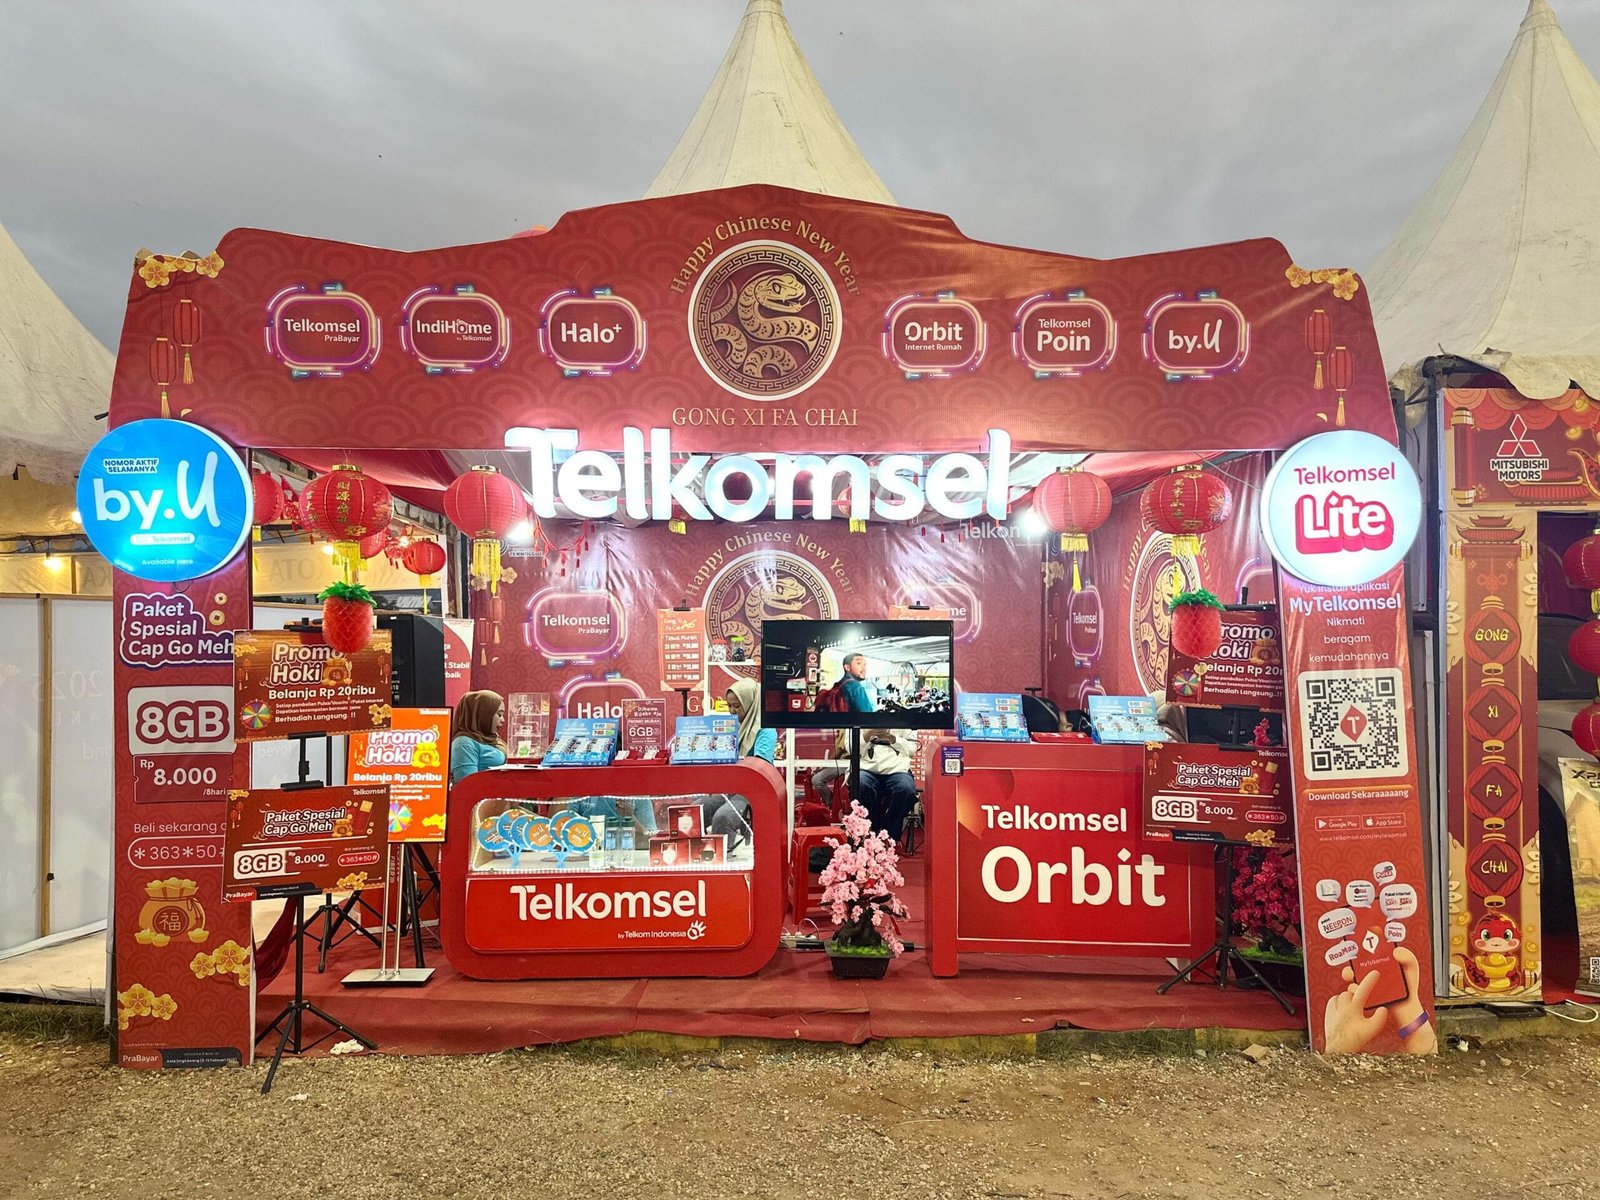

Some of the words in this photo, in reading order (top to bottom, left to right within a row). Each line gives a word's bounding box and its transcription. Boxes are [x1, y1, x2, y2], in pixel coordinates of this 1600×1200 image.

[670, 236, 715, 295] Happy
[714, 216, 792, 241] Chinese
[795, 219, 836, 254] New
[833, 250, 860, 296] Year
[284, 318, 361, 333] Telkomsel
[416, 318, 492, 335] IndiHome
[1038, 318, 1091, 329] Telkomsel
[904, 321, 963, 341] Orbit
[1168, 318, 1223, 354] by.U
[324, 334, 360, 343] PraBayar
[1037, 330, 1091, 352] Poin
[905, 343, 935, 351] Internet
[936, 343, 962, 351] Rumah
[672, 407, 735, 426] GONG
[742, 408, 765, 426] XI
[772, 408, 799, 426] FA
[805, 408, 859, 427] CHAI
[1491, 460, 1548, 470] MITSUBISHI
[504, 426, 1011, 522] Telkomsel
[1294, 461, 1396, 485] Telkomsel
[1499, 470, 1541, 480] MOTORS
[93, 451, 221, 530] by.U
[1299, 493, 1389, 546] Lite
[686, 547, 725, 598] Happy
[725, 531, 792, 552] Chinese
[796, 533, 830, 560] New
[829, 557, 854, 594] Year
[1349, 580, 1390, 593] aplikasi
[131, 601, 185, 617] Paket
[1289, 593, 1401, 616] MyTelkomsel
[542, 613, 611, 627] Telkomsel
[1072, 612, 1098, 624] Telkomsel
[1326, 616, 1365, 627] Nikmati
[129, 620, 197, 640] Spesial
[578, 627, 610, 635] PraBayar
[1220, 625, 1275, 640] romo
[1475, 628, 1509, 641] GONG
[1323, 634, 1371, 646] beragam
[128, 640, 163, 659] Cap
[168, 640, 194, 655] Go
[197, 639, 234, 654] Meh
[1308, 652, 1389, 663] kemudahannya
[448, 661, 471, 669] Stabil
[1247, 665, 1263, 676] Rp
[272, 663, 321, 683] Hoki
[268, 687, 317, 701] Belanja
[319, 687, 336, 700] Rp
[338, 685, 376, 697] 20ribu
[1204, 687, 1239, 695] Berhadiah
[275, 714, 313, 723] Berhadiah
[1487, 705, 1499, 719] XI
[139, 703, 227, 742] 8GB
[370, 731, 434, 745] Promo
[629, 727, 653, 736] 6GB
[367, 746, 412, 764] Hoki
[140, 759, 154, 769] Rp
[1178, 764, 1209, 774] Paket
[1211, 766, 1251, 777] Spesial
[153, 767, 217, 786] 8.000
[353, 773, 392, 784] Belanja
[394, 773, 408, 783] Rp
[410, 772, 442, 782] 20ribu
[1177, 775, 1199, 787] Cap
[1200, 777, 1215, 785] Go
[1217, 777, 1239, 787] Meh
[202, 788, 226, 796] /8hari
[352, 787, 387, 796] Telkomsel
[1308, 791, 1350, 801] Download
[1486, 784, 1503, 797] FA
[266, 811, 300, 823] Paket
[301, 809, 345, 821] Spesial
[1155, 800, 1195, 818] 8GB
[1205, 806, 1233, 815] 8.000
[981, 804, 1127, 832] Telkomsel
[133, 823, 155, 833] Beli
[159, 821, 217, 834] sekarang
[264, 824, 288, 836] Cap
[290, 823, 306, 833] Go
[308, 821, 333, 831] Meh
[237, 853, 283, 875] 8GB
[294, 853, 326, 865] 8.000
[1480, 860, 1508, 874] CHAI
[981, 845, 1166, 907] Orbit
[225, 891, 254, 899] PraBayar
[510, 879, 706, 921] Telkomsel
[158, 912, 182, 931] 福
[624, 930, 651, 938] Telkom
[651, 929, 687, 938] Indonesia
[1387, 930, 1402, 938] Poin
[1328, 944, 1357, 961] RoaMax
[122, 1054, 158, 1063] PraBayar
